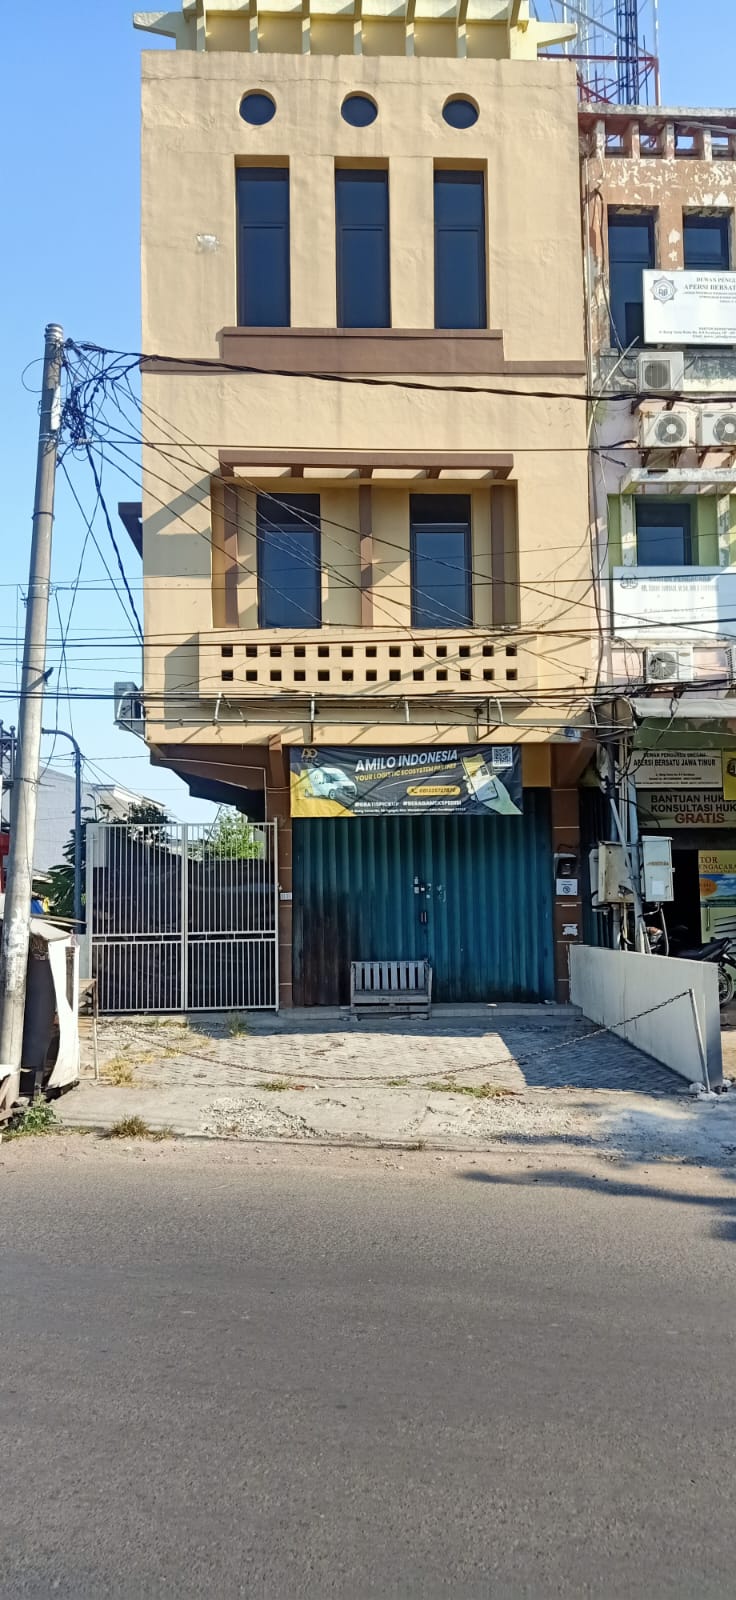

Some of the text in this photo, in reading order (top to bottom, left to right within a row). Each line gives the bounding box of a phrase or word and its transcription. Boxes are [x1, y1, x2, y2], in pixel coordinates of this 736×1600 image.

[355, 750, 458, 772] AMILO INDONESIA
[354, 773, 373, 782] YOUR
[401, 766, 433, 776] ECOSYSTEM
[651, 794, 736, 803] BANTUAN HUK
[651, 804, 713, 812] KONSULTASI
[675, 813, 725, 824] GRATIS
